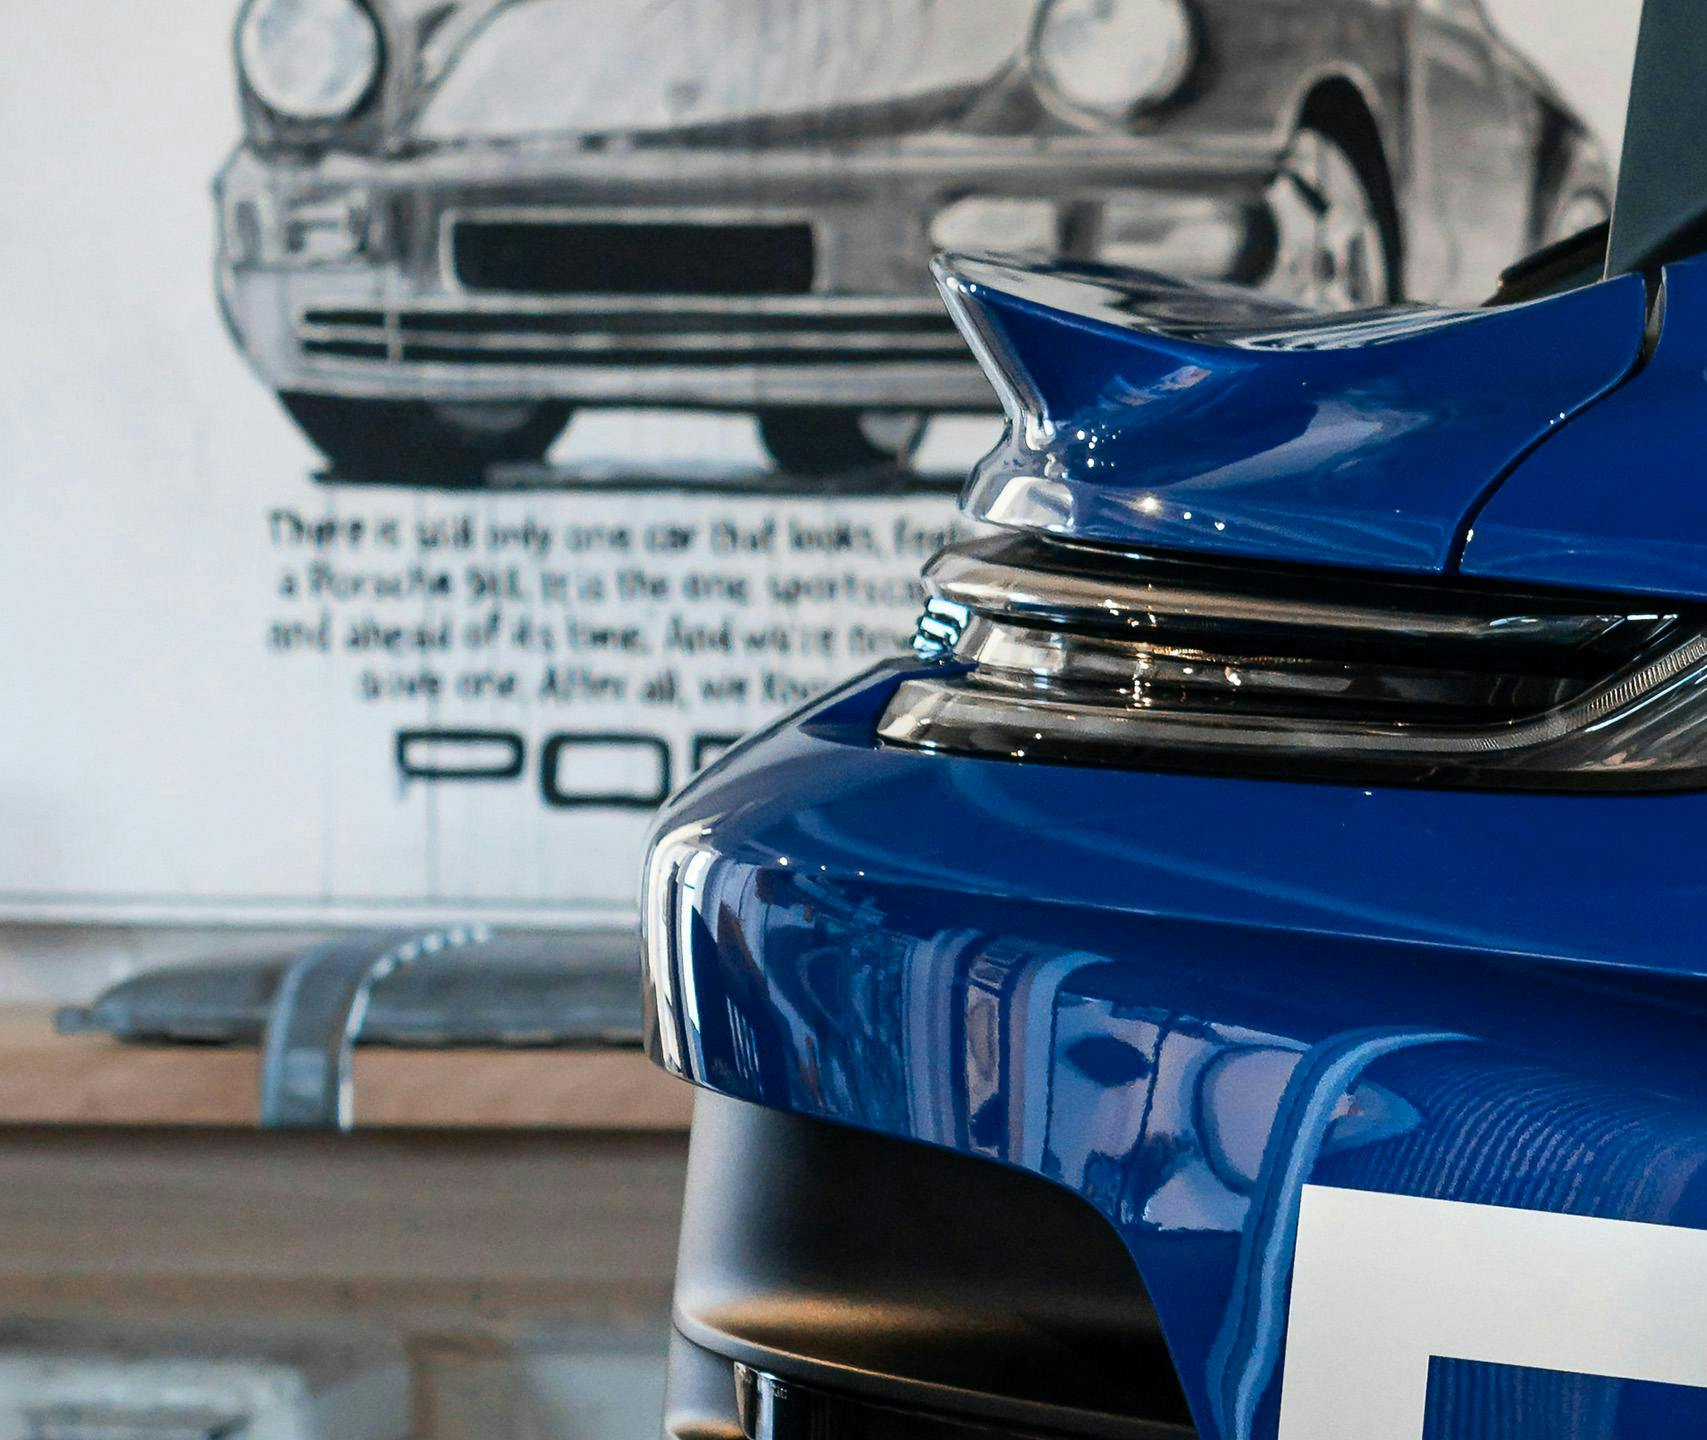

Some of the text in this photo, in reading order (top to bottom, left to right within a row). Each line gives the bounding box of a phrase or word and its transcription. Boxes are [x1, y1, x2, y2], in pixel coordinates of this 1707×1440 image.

[267, 508, 364, 547] There
[486, 513, 551, 557] only
[565, 522, 631, 551] one
[644, 525, 696, 551] car
[710, 516, 775, 551] that
[278, 564, 298, 598] a
[308, 559, 451, 601] Porsche
[615, 567, 668, 601] the
[267, 610, 332, 651] and
[346, 615, 451, 651] ahead
[464, 606, 500, 648] of
[665, 613, 734, 652] And
[540, 664, 626, 702] After
[700, 675, 748, 701] we
